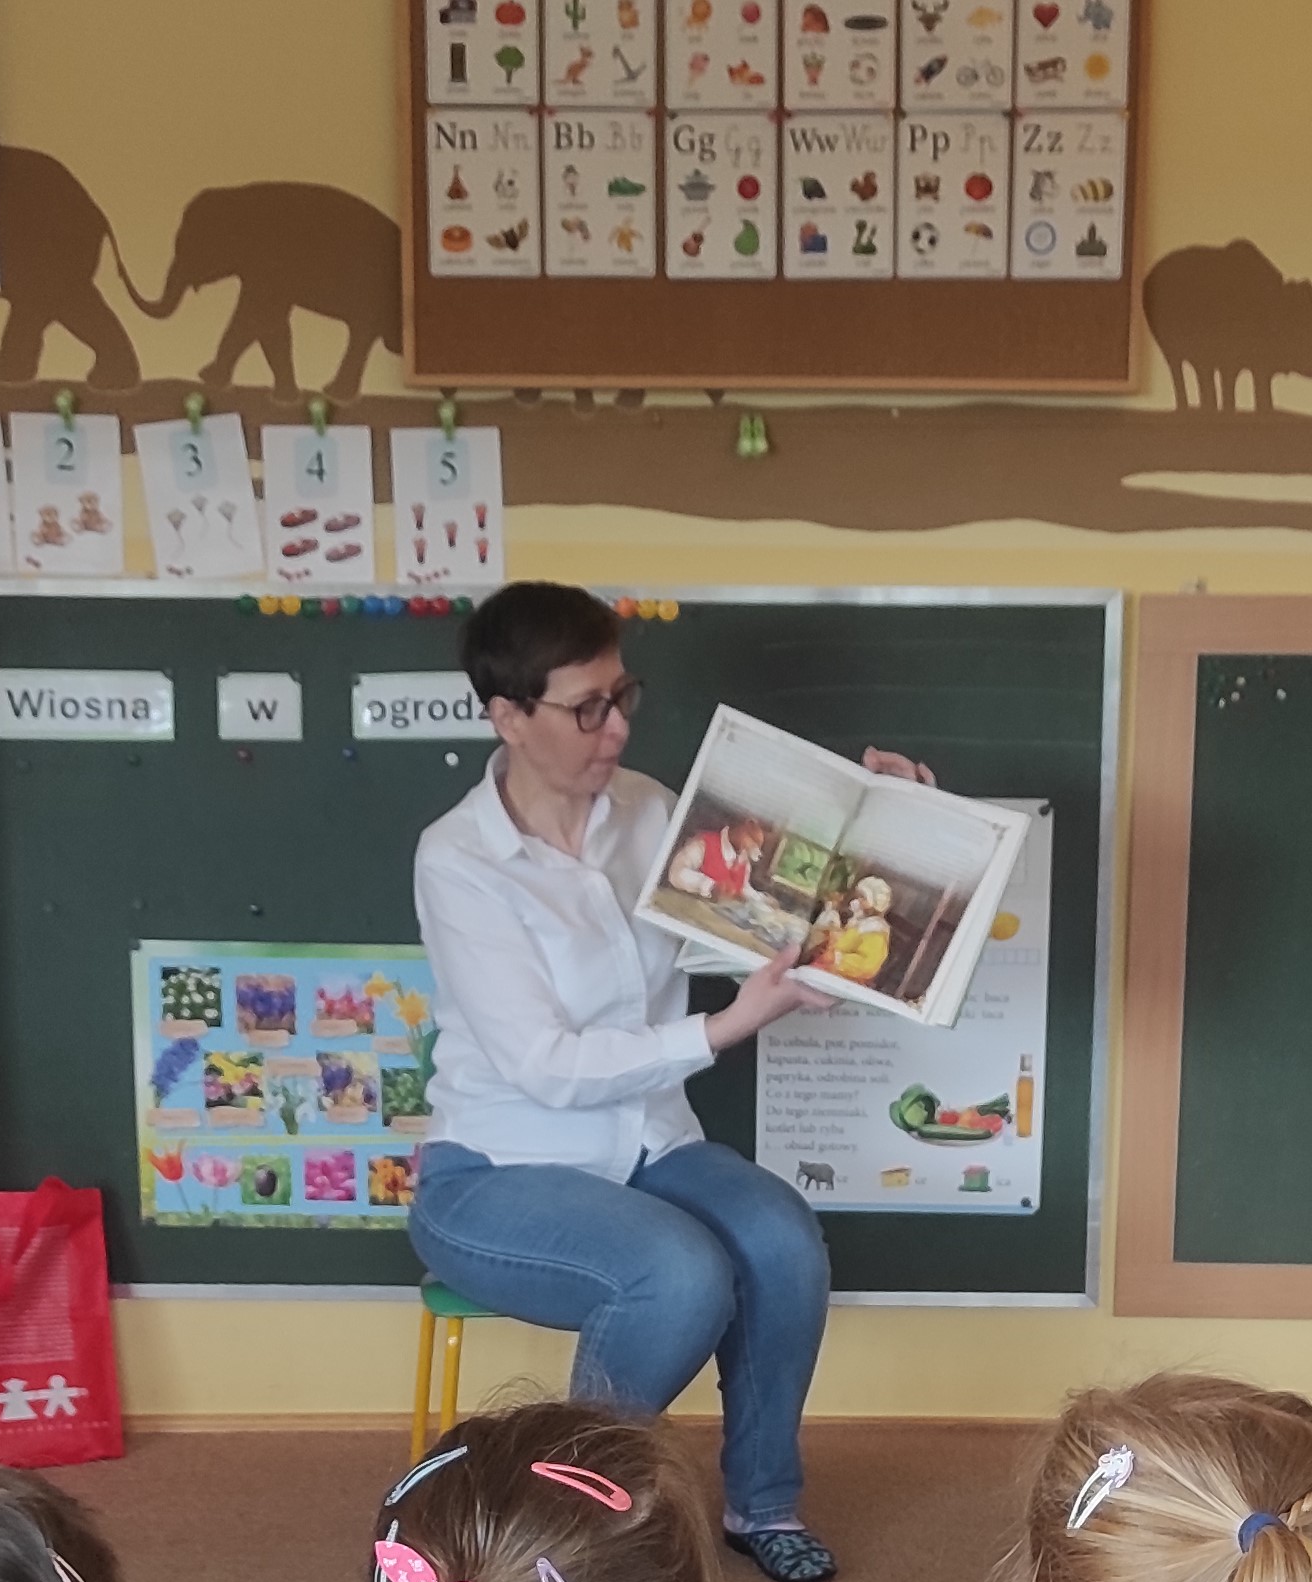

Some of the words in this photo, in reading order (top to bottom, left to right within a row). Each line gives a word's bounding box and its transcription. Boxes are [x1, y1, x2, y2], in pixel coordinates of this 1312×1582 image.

[434, 121, 478, 151] Nn
[553, 121, 596, 151] Bb
[672, 124, 717, 164] Gg
[790, 126, 839, 153] Ww
[909, 123, 950, 163] Pp
[1022, 123, 1064, 153] Zz
[56, 437, 76, 471] 2
[182, 443, 204, 477] 3
[306, 451, 327, 484] 4
[439, 451, 458, 486] 5
[6, 688, 151, 721] Wiosna
[246, 698, 279, 722] w
[767, 1035, 782, 1048] To
